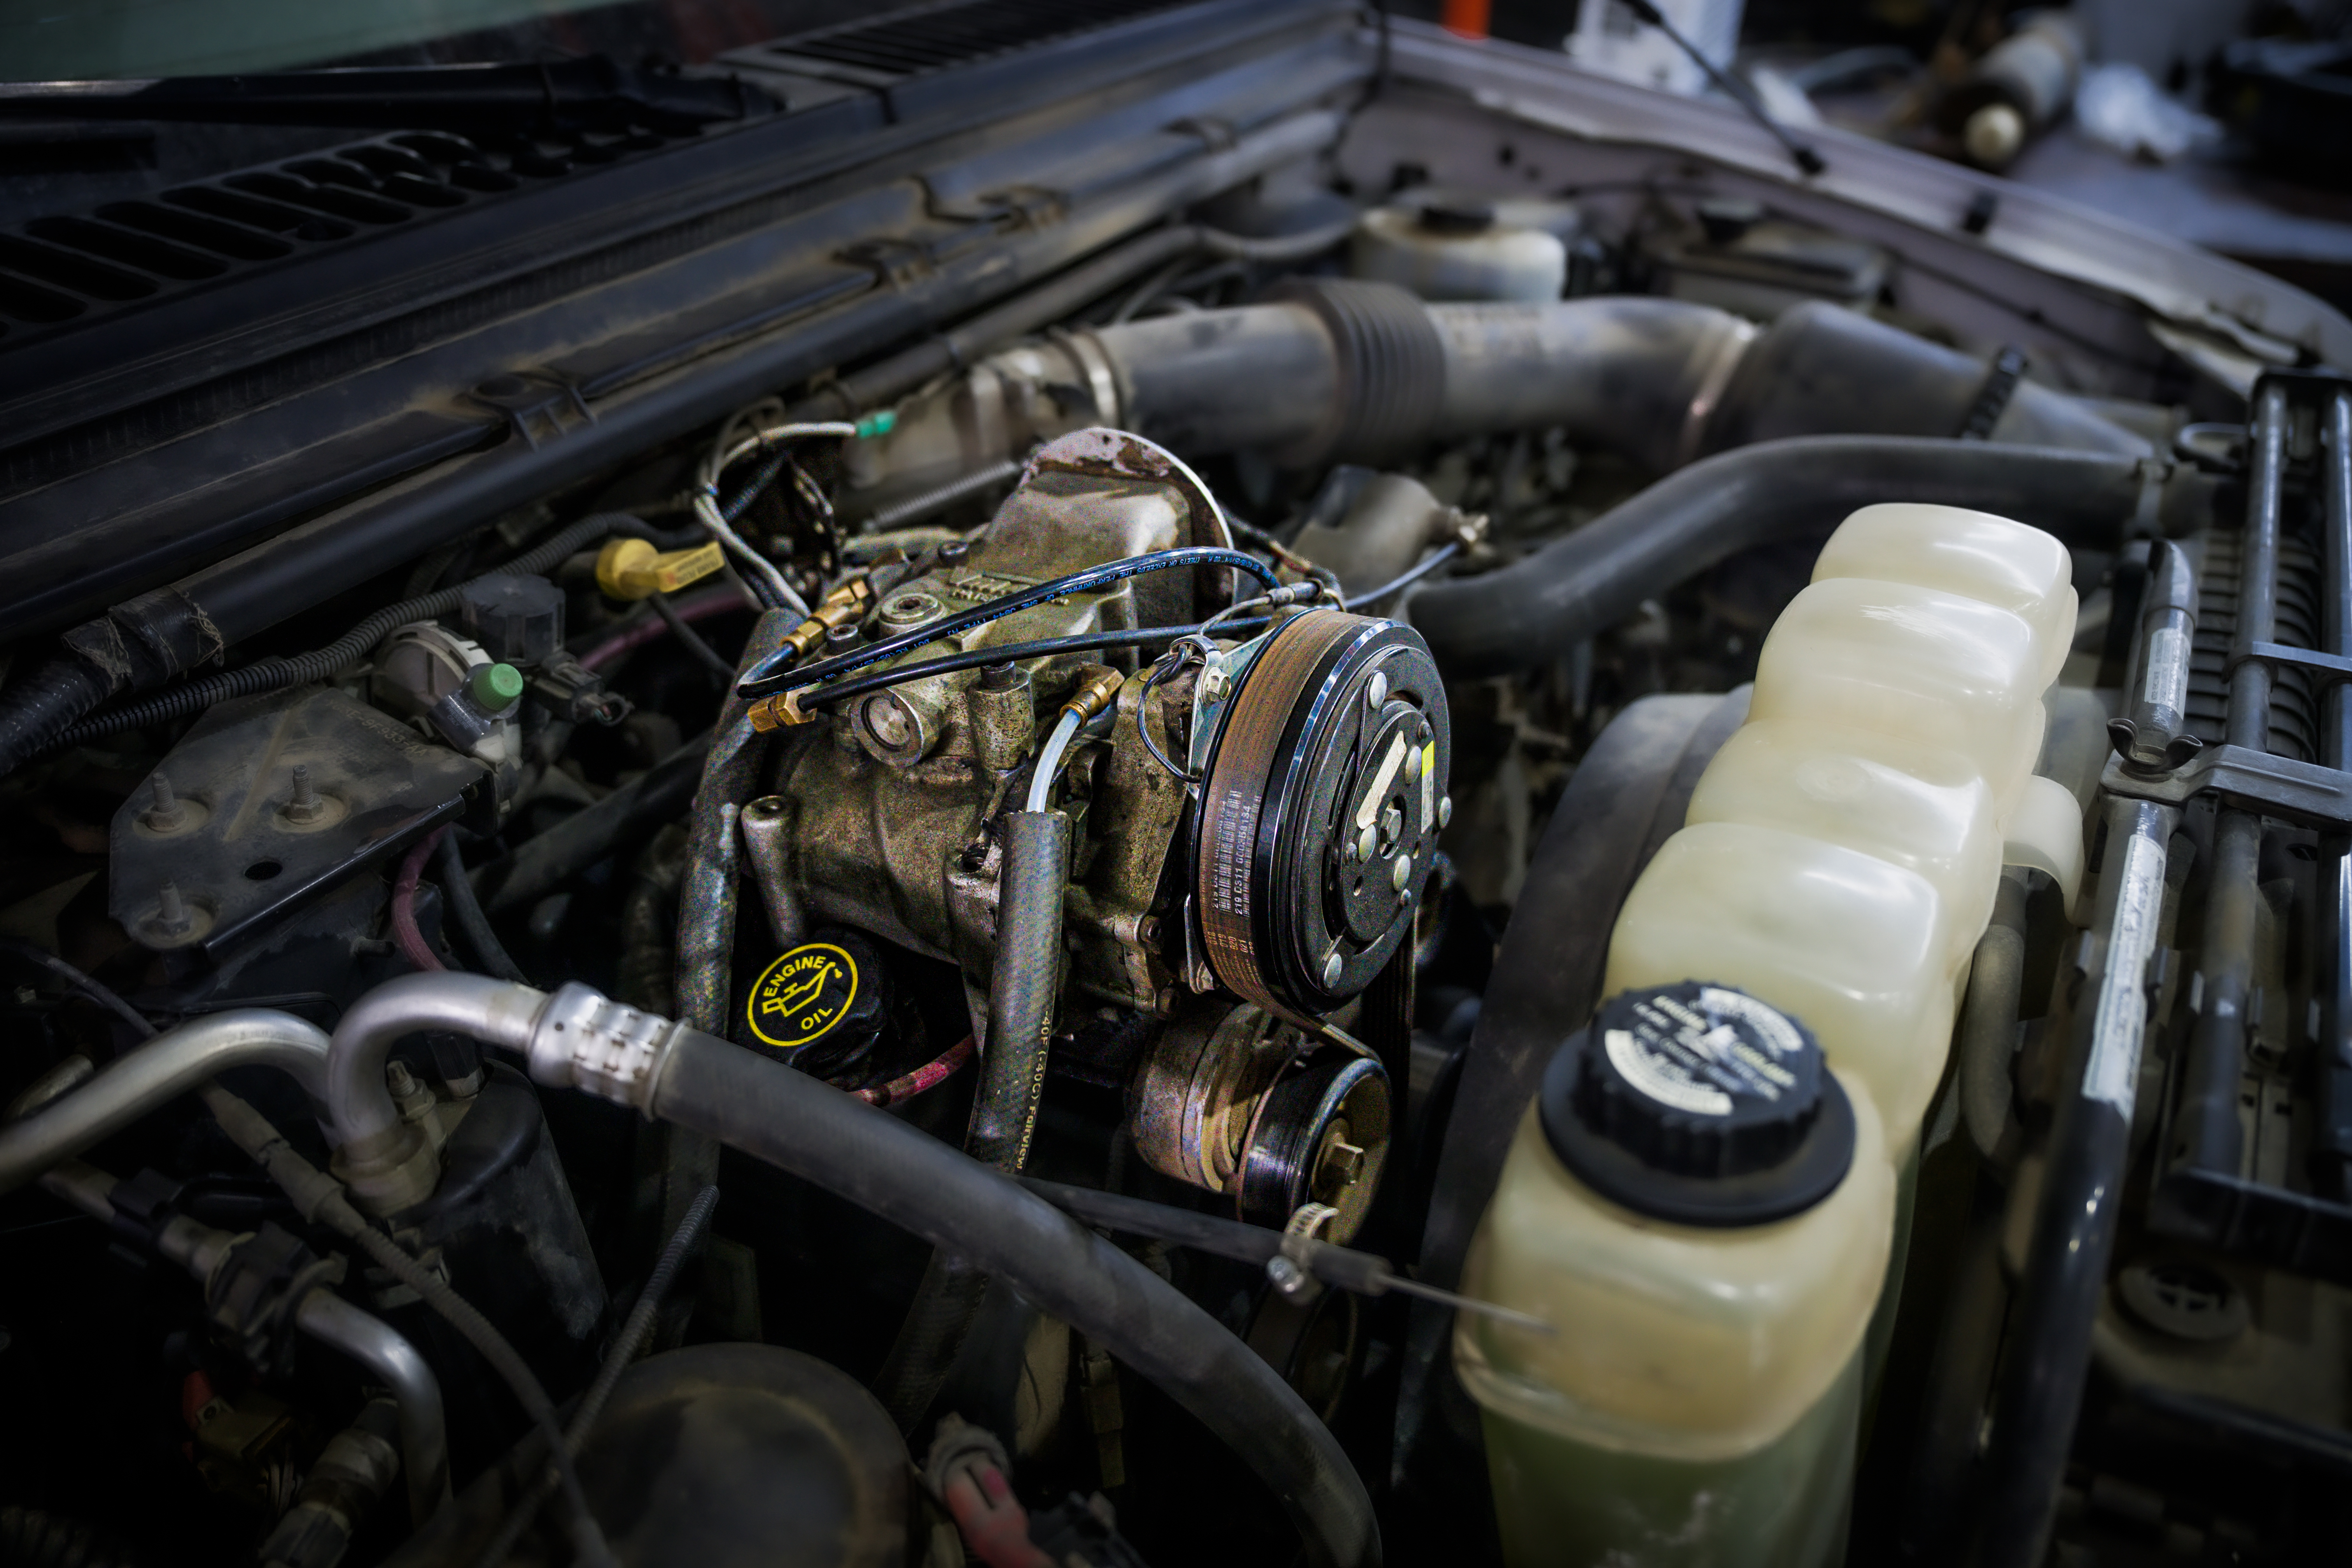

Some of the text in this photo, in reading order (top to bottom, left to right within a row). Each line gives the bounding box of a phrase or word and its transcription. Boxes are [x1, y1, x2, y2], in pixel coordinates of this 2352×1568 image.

[1120, 569, 1132, 579] THE
[1137, 562, 1166, 574] EXCEEDS
[1060, 574, 1115, 595] PERFORMANCE
[447, 706, 470, 730] PRESSURE
[448, 702, 475, 728] REGULATED
[453, 693, 483, 723] SERVICE PORT
[447, 714, 460, 727] ONLY
[1234, 897, 1242, 915] 219
[763, 956, 826, 997] ENGINE
[801, 1008, 833, 1030] OIL
[1040, 1011, 1050, 1045] -40F
[1031, 1050, 1046, 1100] (-40C)
